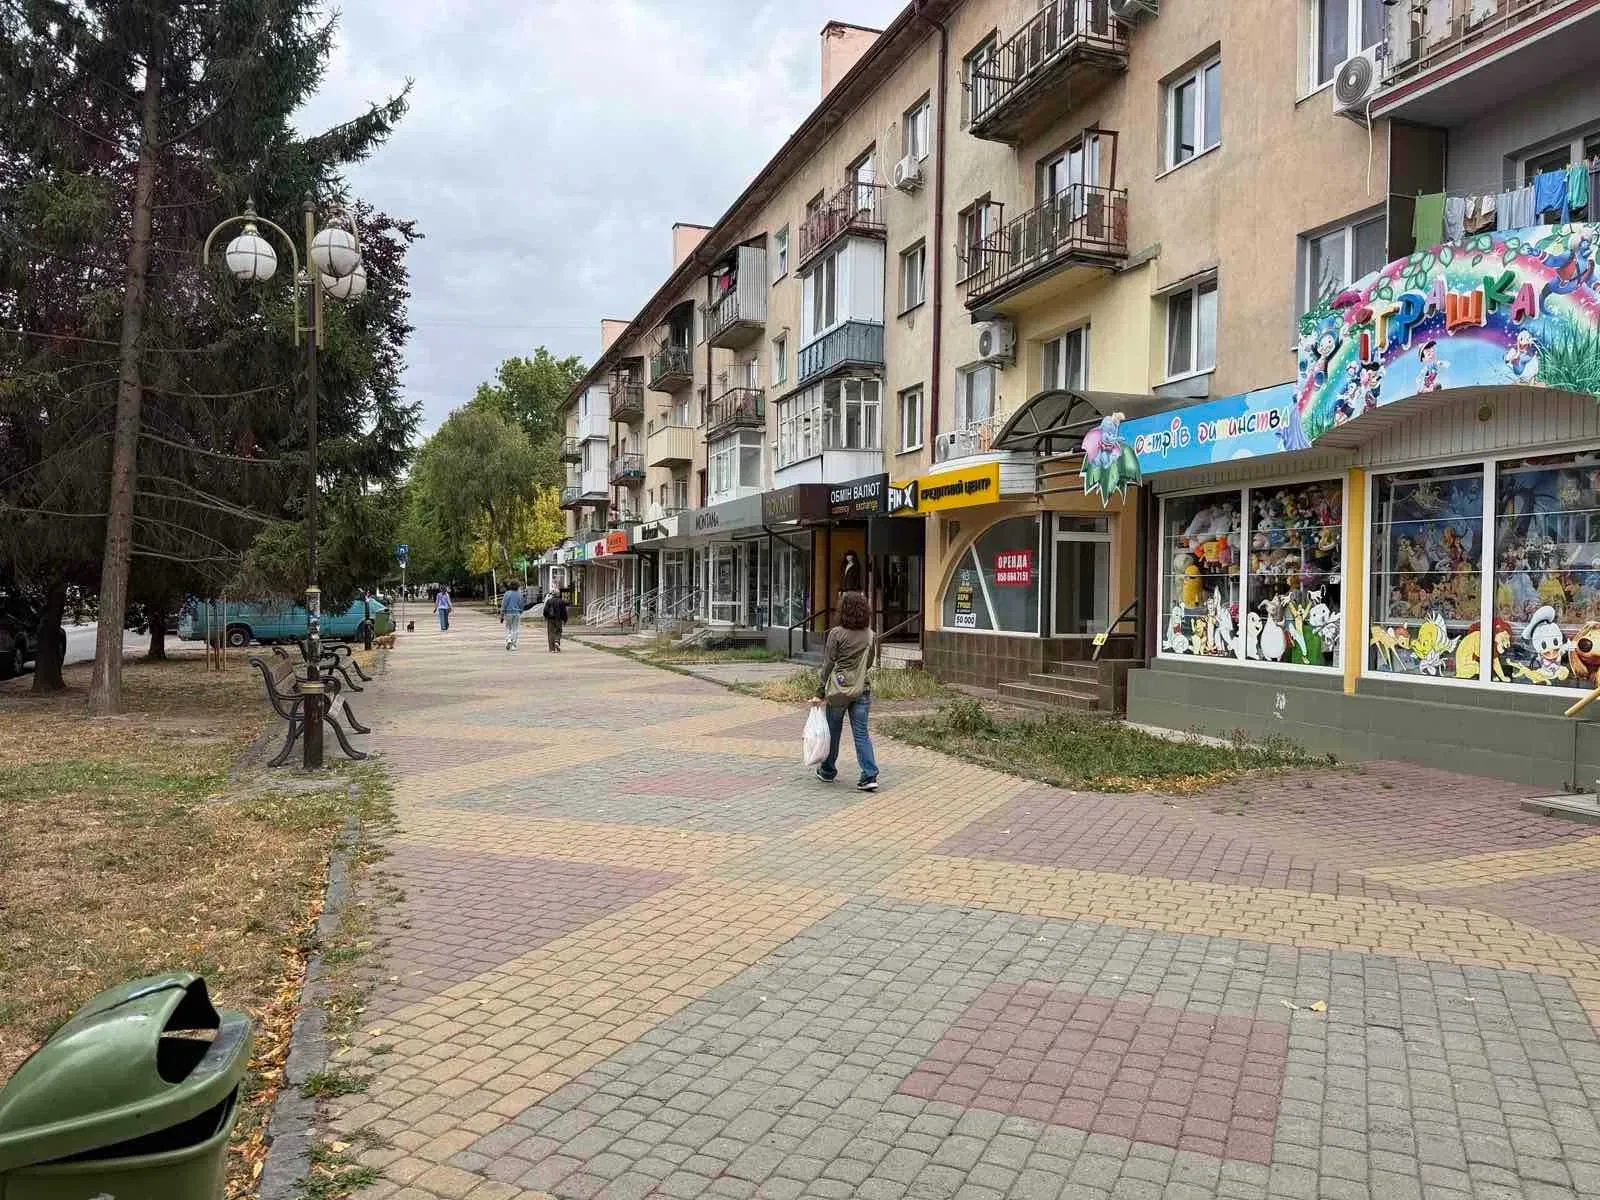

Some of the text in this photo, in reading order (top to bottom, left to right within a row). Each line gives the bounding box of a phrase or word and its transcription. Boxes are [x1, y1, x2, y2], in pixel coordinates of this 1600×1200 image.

[1355, 271, 1536, 363] ІГРАШКА
[853, 481, 881, 500] ВАЛЮТ
[998, 555, 1028, 570] ОРЕНДА
